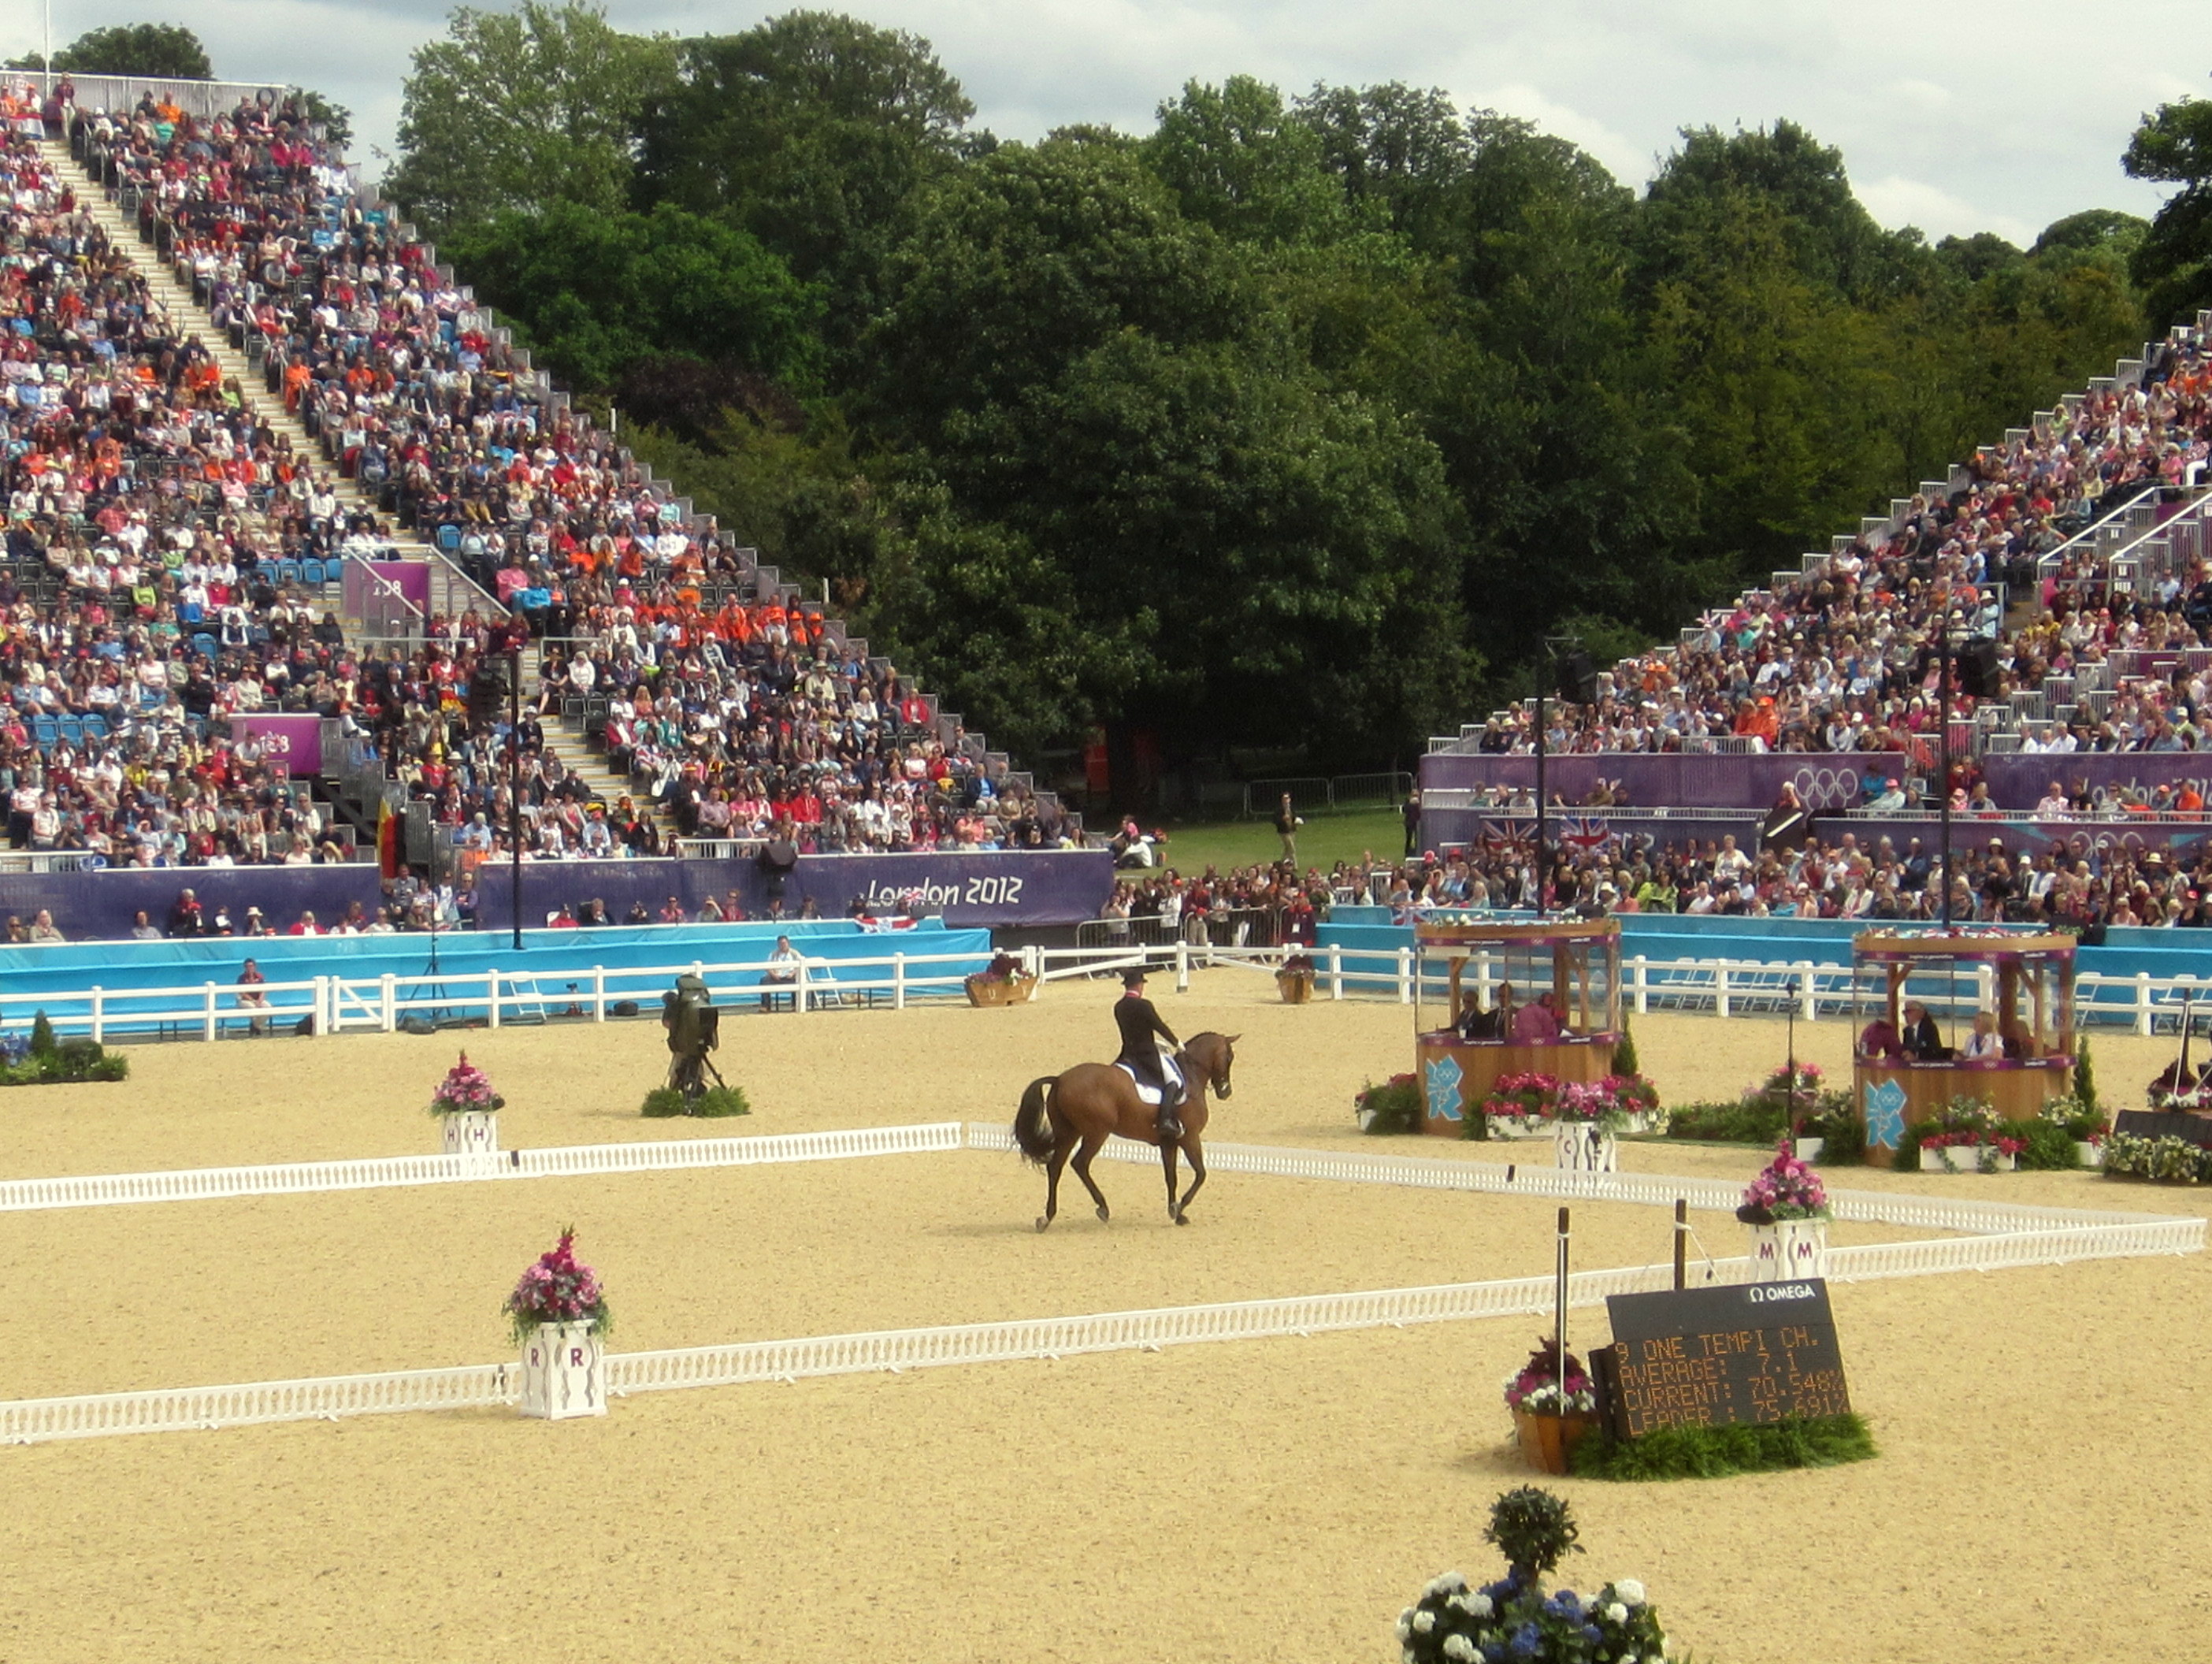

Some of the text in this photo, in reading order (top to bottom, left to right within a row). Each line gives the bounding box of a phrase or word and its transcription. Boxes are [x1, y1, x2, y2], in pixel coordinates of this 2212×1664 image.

[868, 875, 1022, 906] London 2012
[447, 1129, 455, 1142] H
[473, 1128, 484, 1142] H
[1760, 1242, 1774, 1260] M
[1797, 1242, 1813, 1260] M
[1765, 1284, 1816, 1302] OMEGA
[1642, 1337, 1686, 1361] ONE
[1698, 1329, 1766, 1356] TEMPI
[1780, 1325, 1819, 1349] CH.
[531, 1348, 540, 1367] R
[571, 1347, 585, 1367] R
[1619, 1350, 1798, 1389] AVERAGE: 7.1
[1624, 1381, 1731, 1411] CURRENT:
